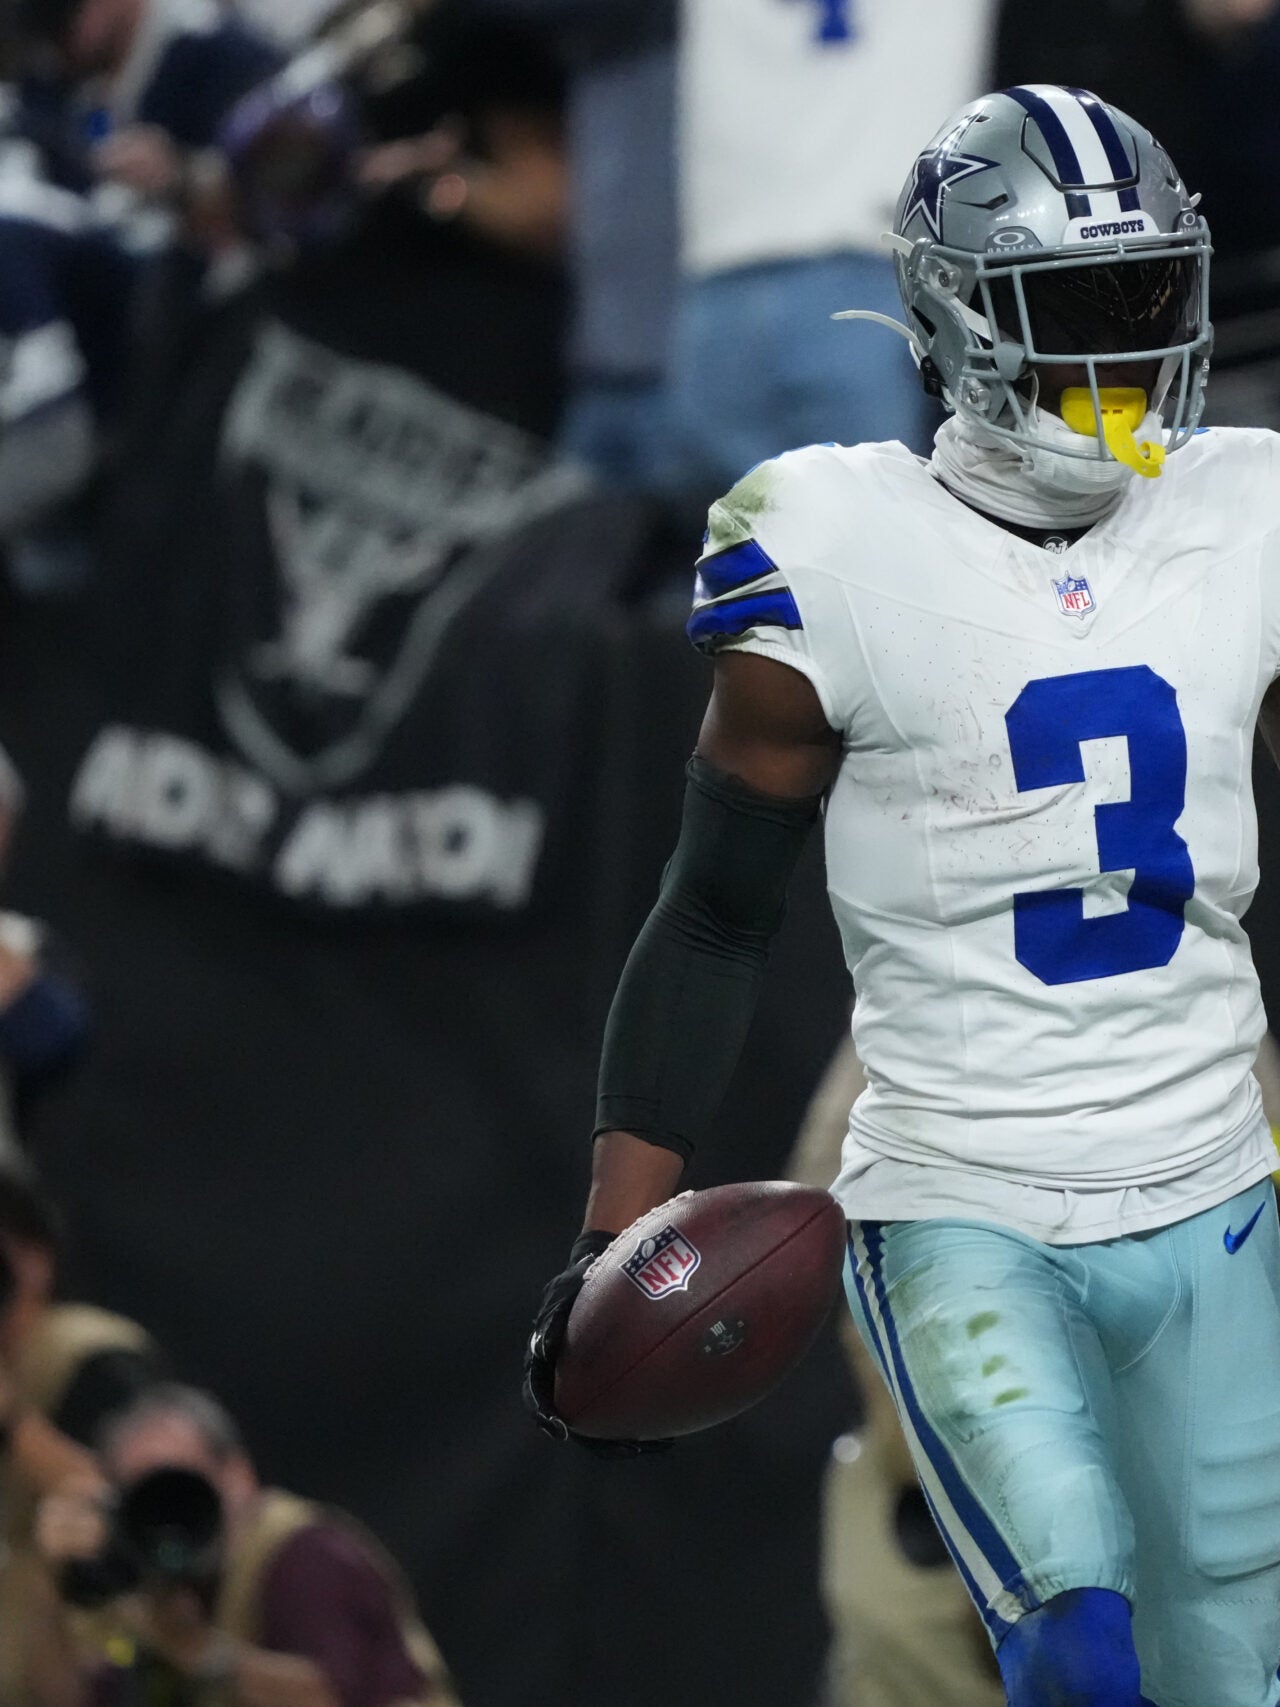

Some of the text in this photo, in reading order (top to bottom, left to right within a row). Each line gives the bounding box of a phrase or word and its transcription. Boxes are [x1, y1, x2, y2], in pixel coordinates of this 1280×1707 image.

[1080, 219, 1145, 240] COWBOYS
[1062, 591, 1091, 610] NFL
[1004, 664, 1196, 986] 3
[637, 1243, 694, 1293] NFL
[709, 1320, 727, 1337] 101
